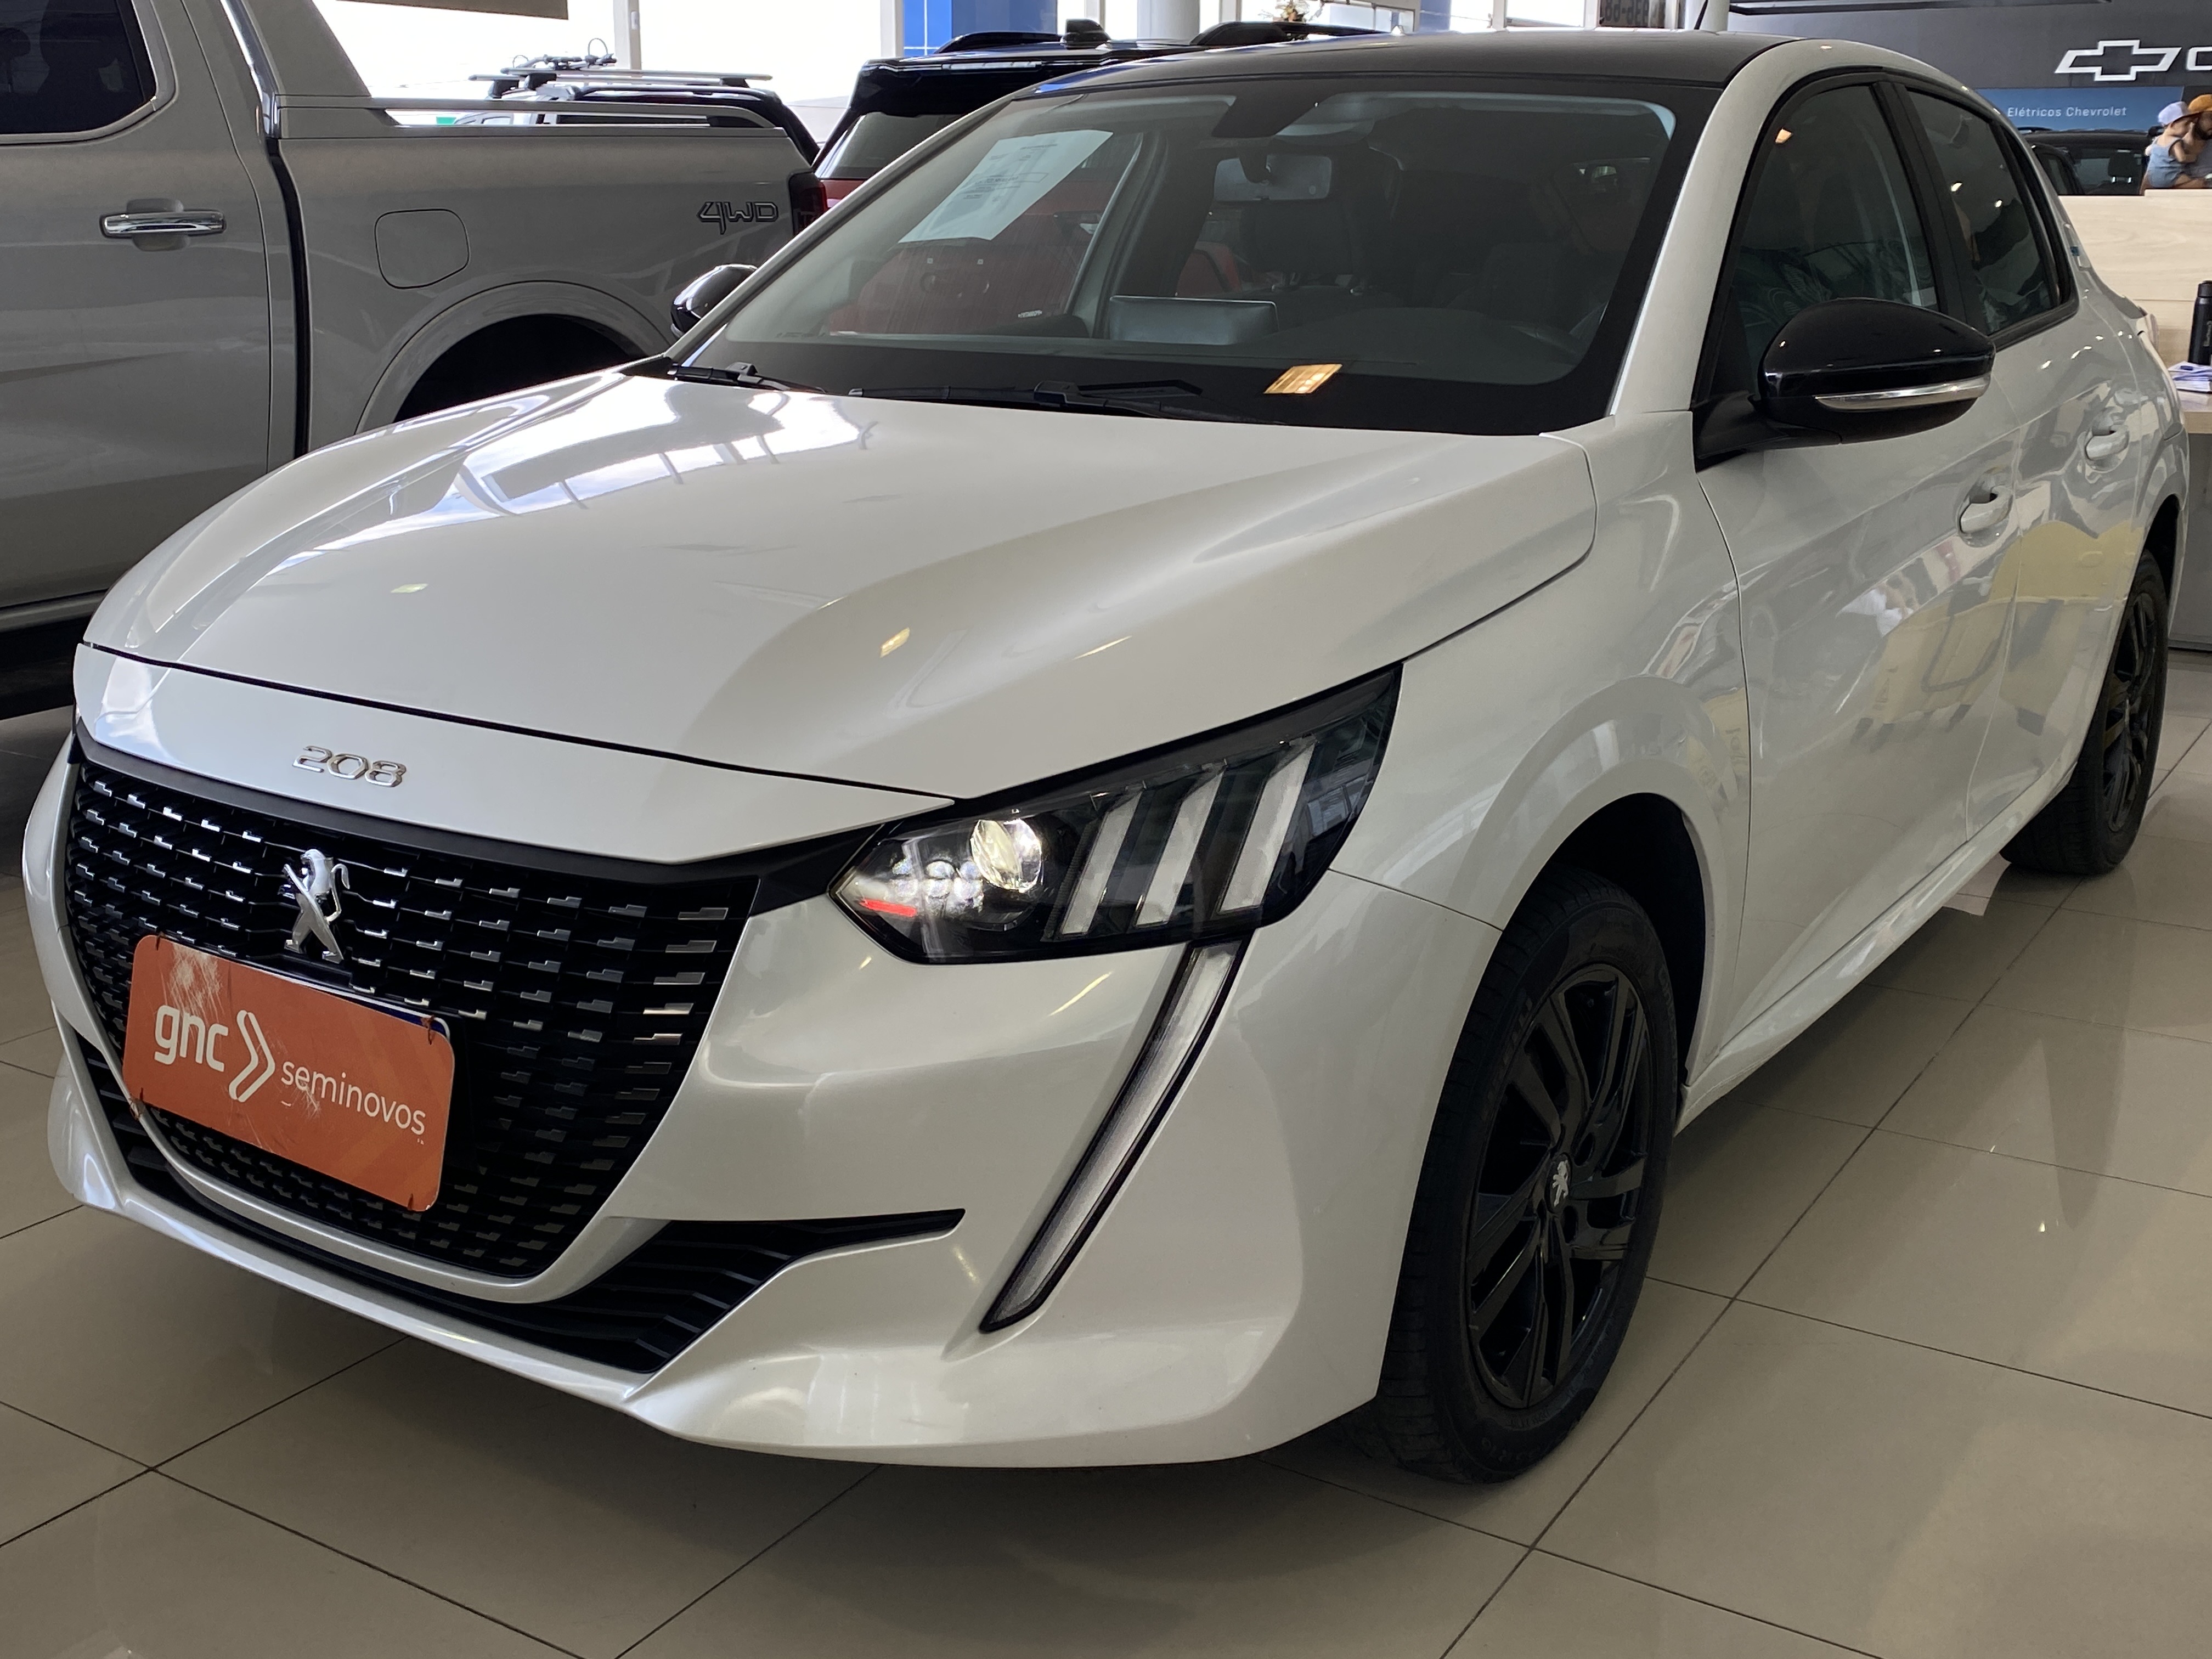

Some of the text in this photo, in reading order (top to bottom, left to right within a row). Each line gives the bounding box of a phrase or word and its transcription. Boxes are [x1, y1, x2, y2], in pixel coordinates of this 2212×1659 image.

[2007, 106, 2126, 117] Elétricos Chevrolet
[696, 201, 779, 235] 4WD
[292, 745, 407, 788] 208
[154, 1005, 426, 1135] gnc seminovos
